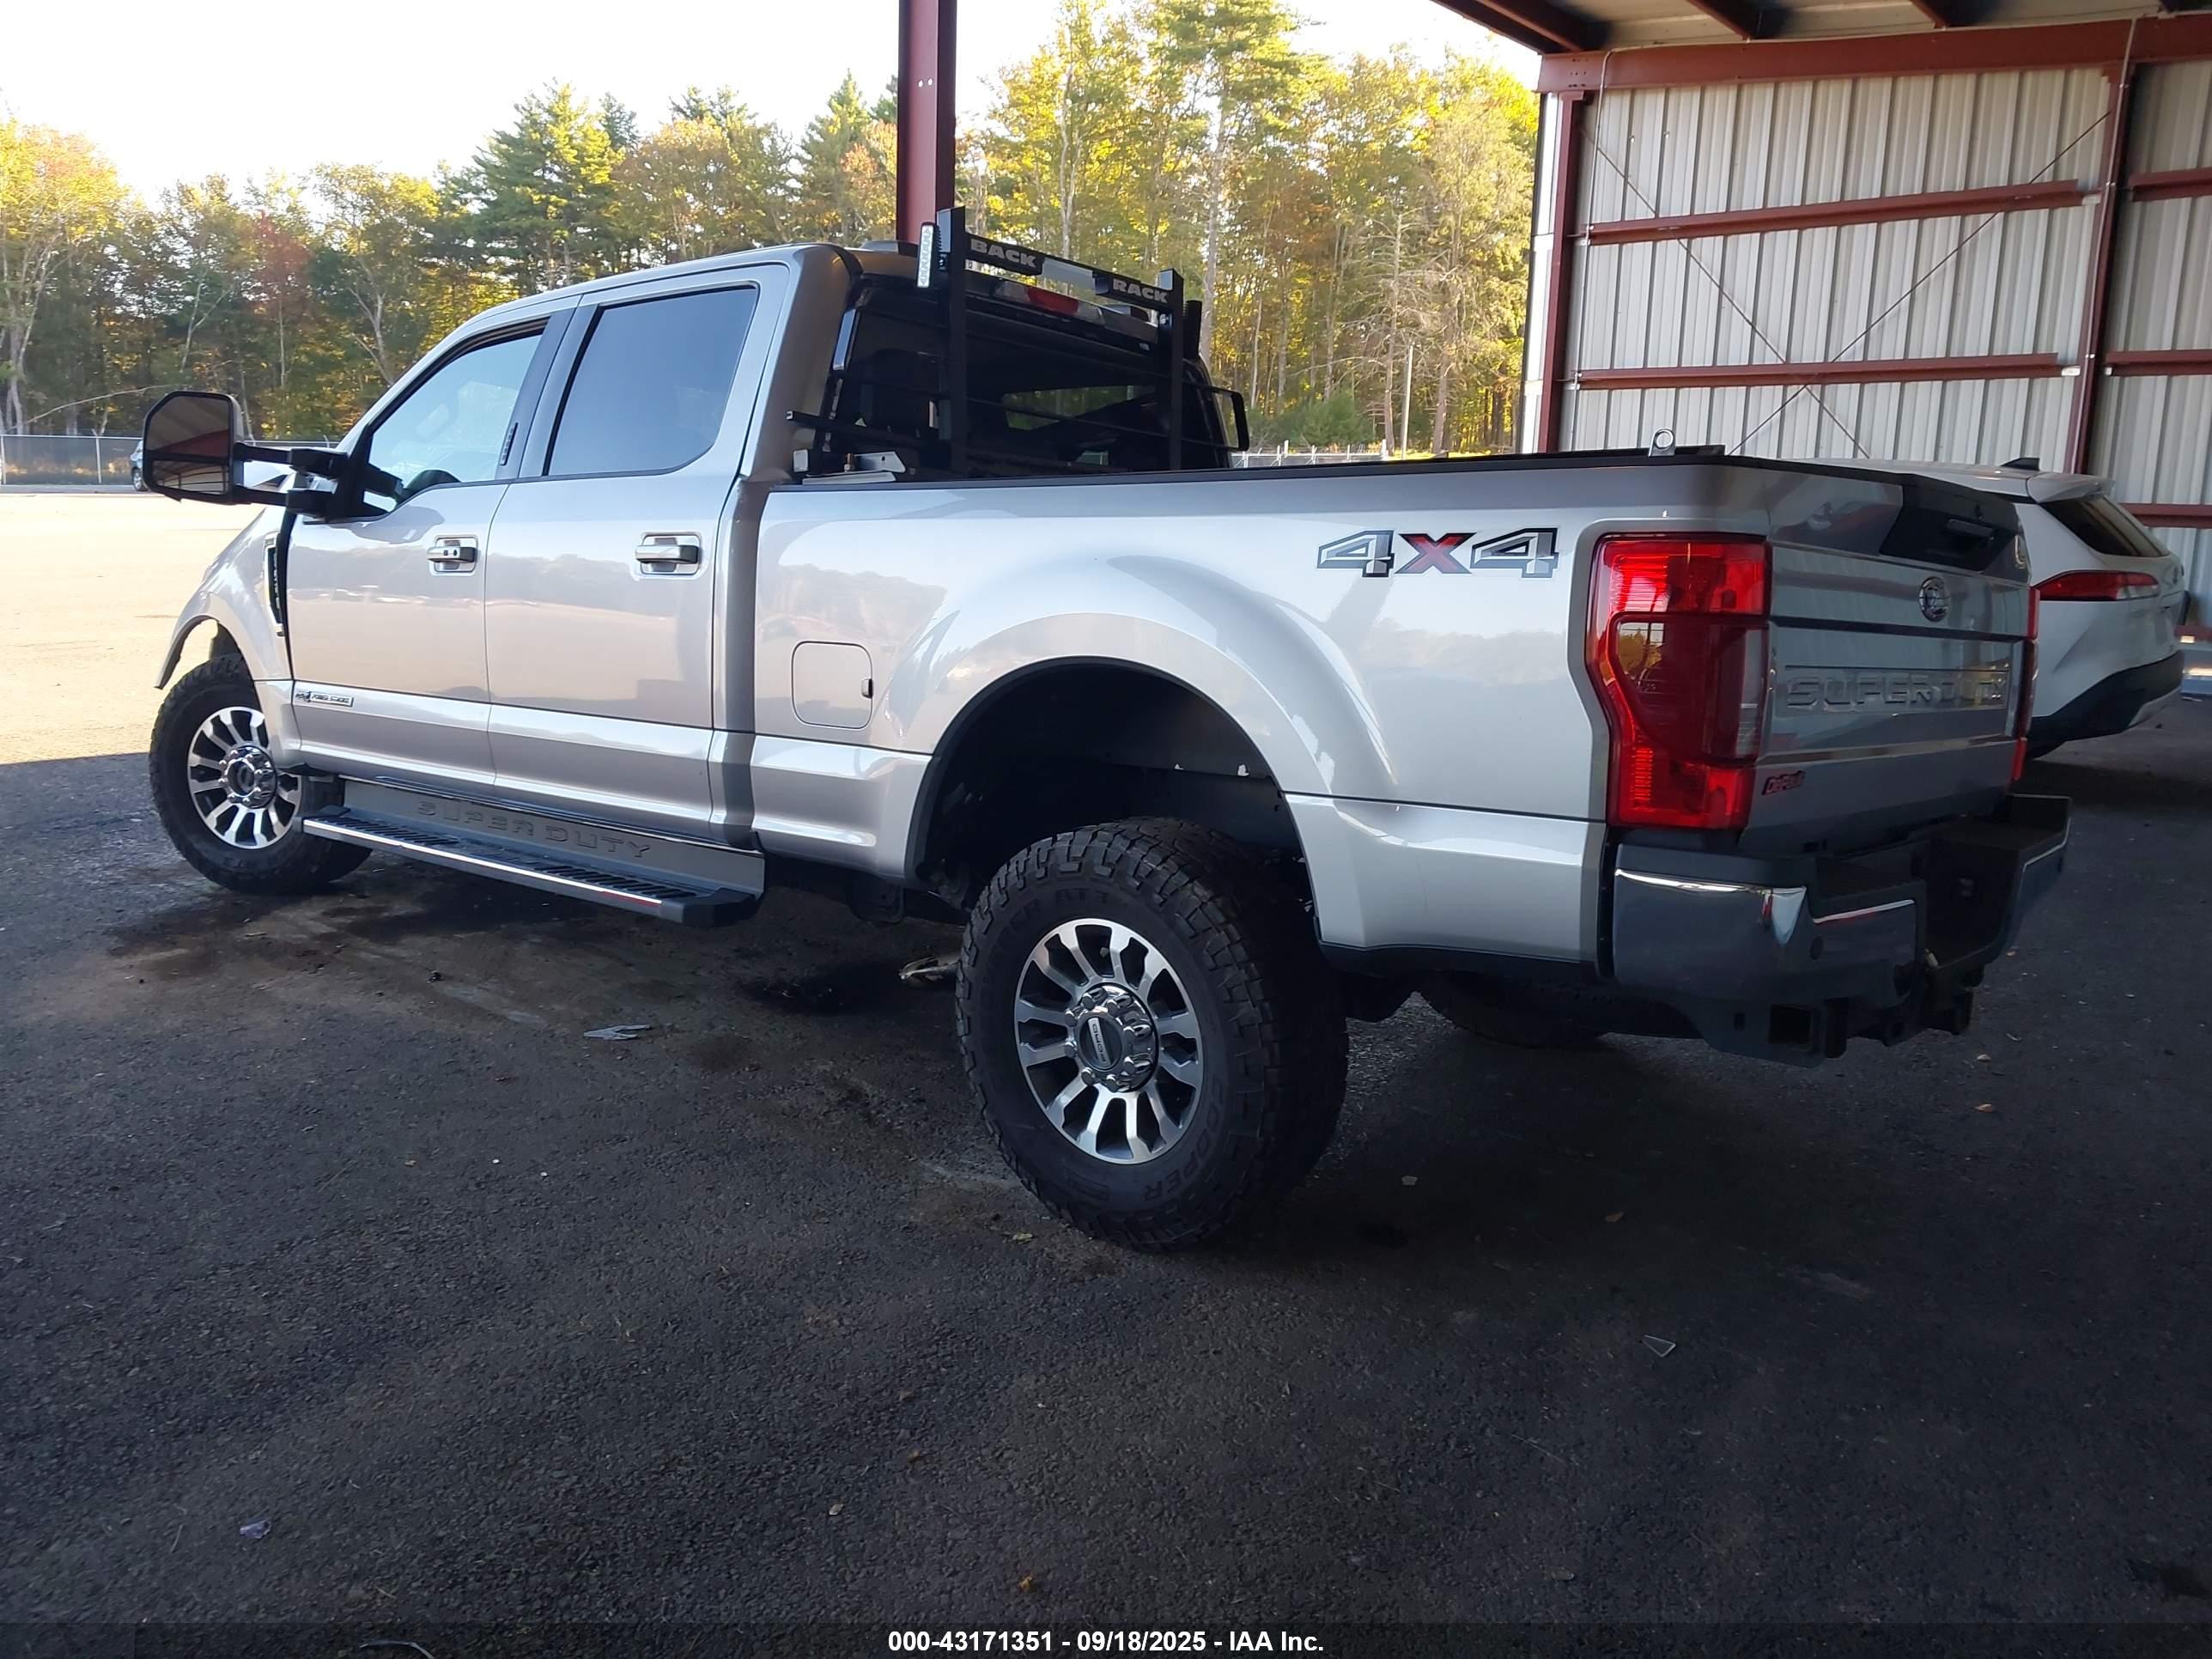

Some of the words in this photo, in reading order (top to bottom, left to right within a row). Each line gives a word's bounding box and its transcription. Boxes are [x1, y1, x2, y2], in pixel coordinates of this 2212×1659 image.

[969, 238, 1037, 268] BACK
[1112, 277, 1169, 302] RACK
[1785, 672, 1937, 711] SUPER
[418, 799, 535, 836] SUPER
[544, 824, 651, 859] DUTY
[1144, 1079, 1223, 1202] COOPER
